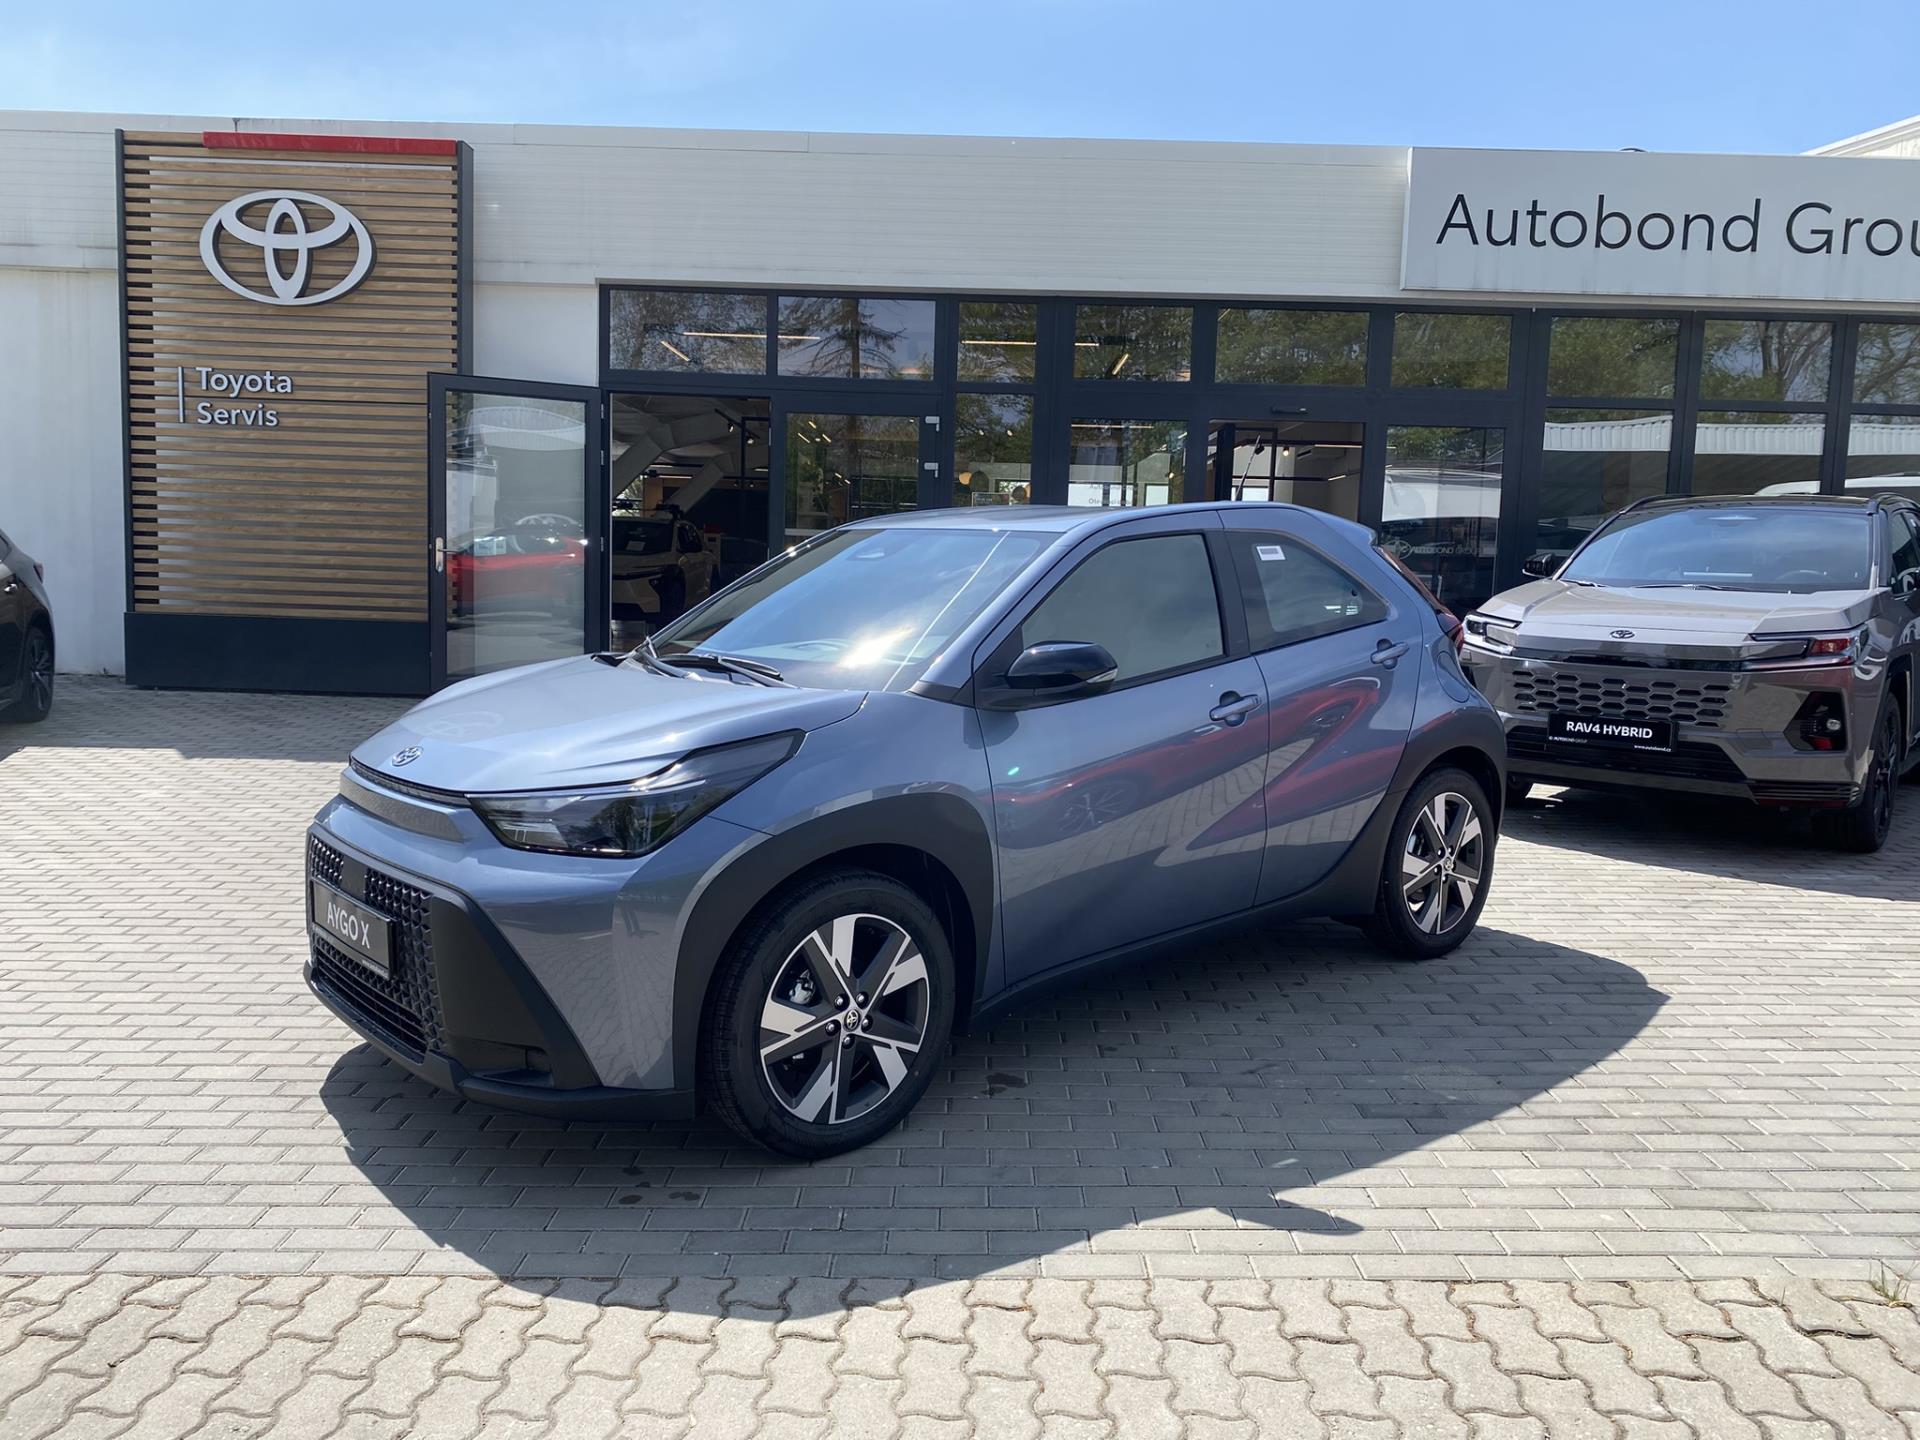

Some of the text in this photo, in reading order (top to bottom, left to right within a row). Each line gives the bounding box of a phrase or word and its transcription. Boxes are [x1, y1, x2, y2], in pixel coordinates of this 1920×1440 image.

[1436, 194, 1761, 252] Autobond
[195, 366, 292, 398] Toyota
[196, 402, 279, 427] Servis
[1566, 721, 1653, 739] RAV4 HYBRID
[327, 901, 358, 941] AYGO
[361, 920, 370, 949] X
